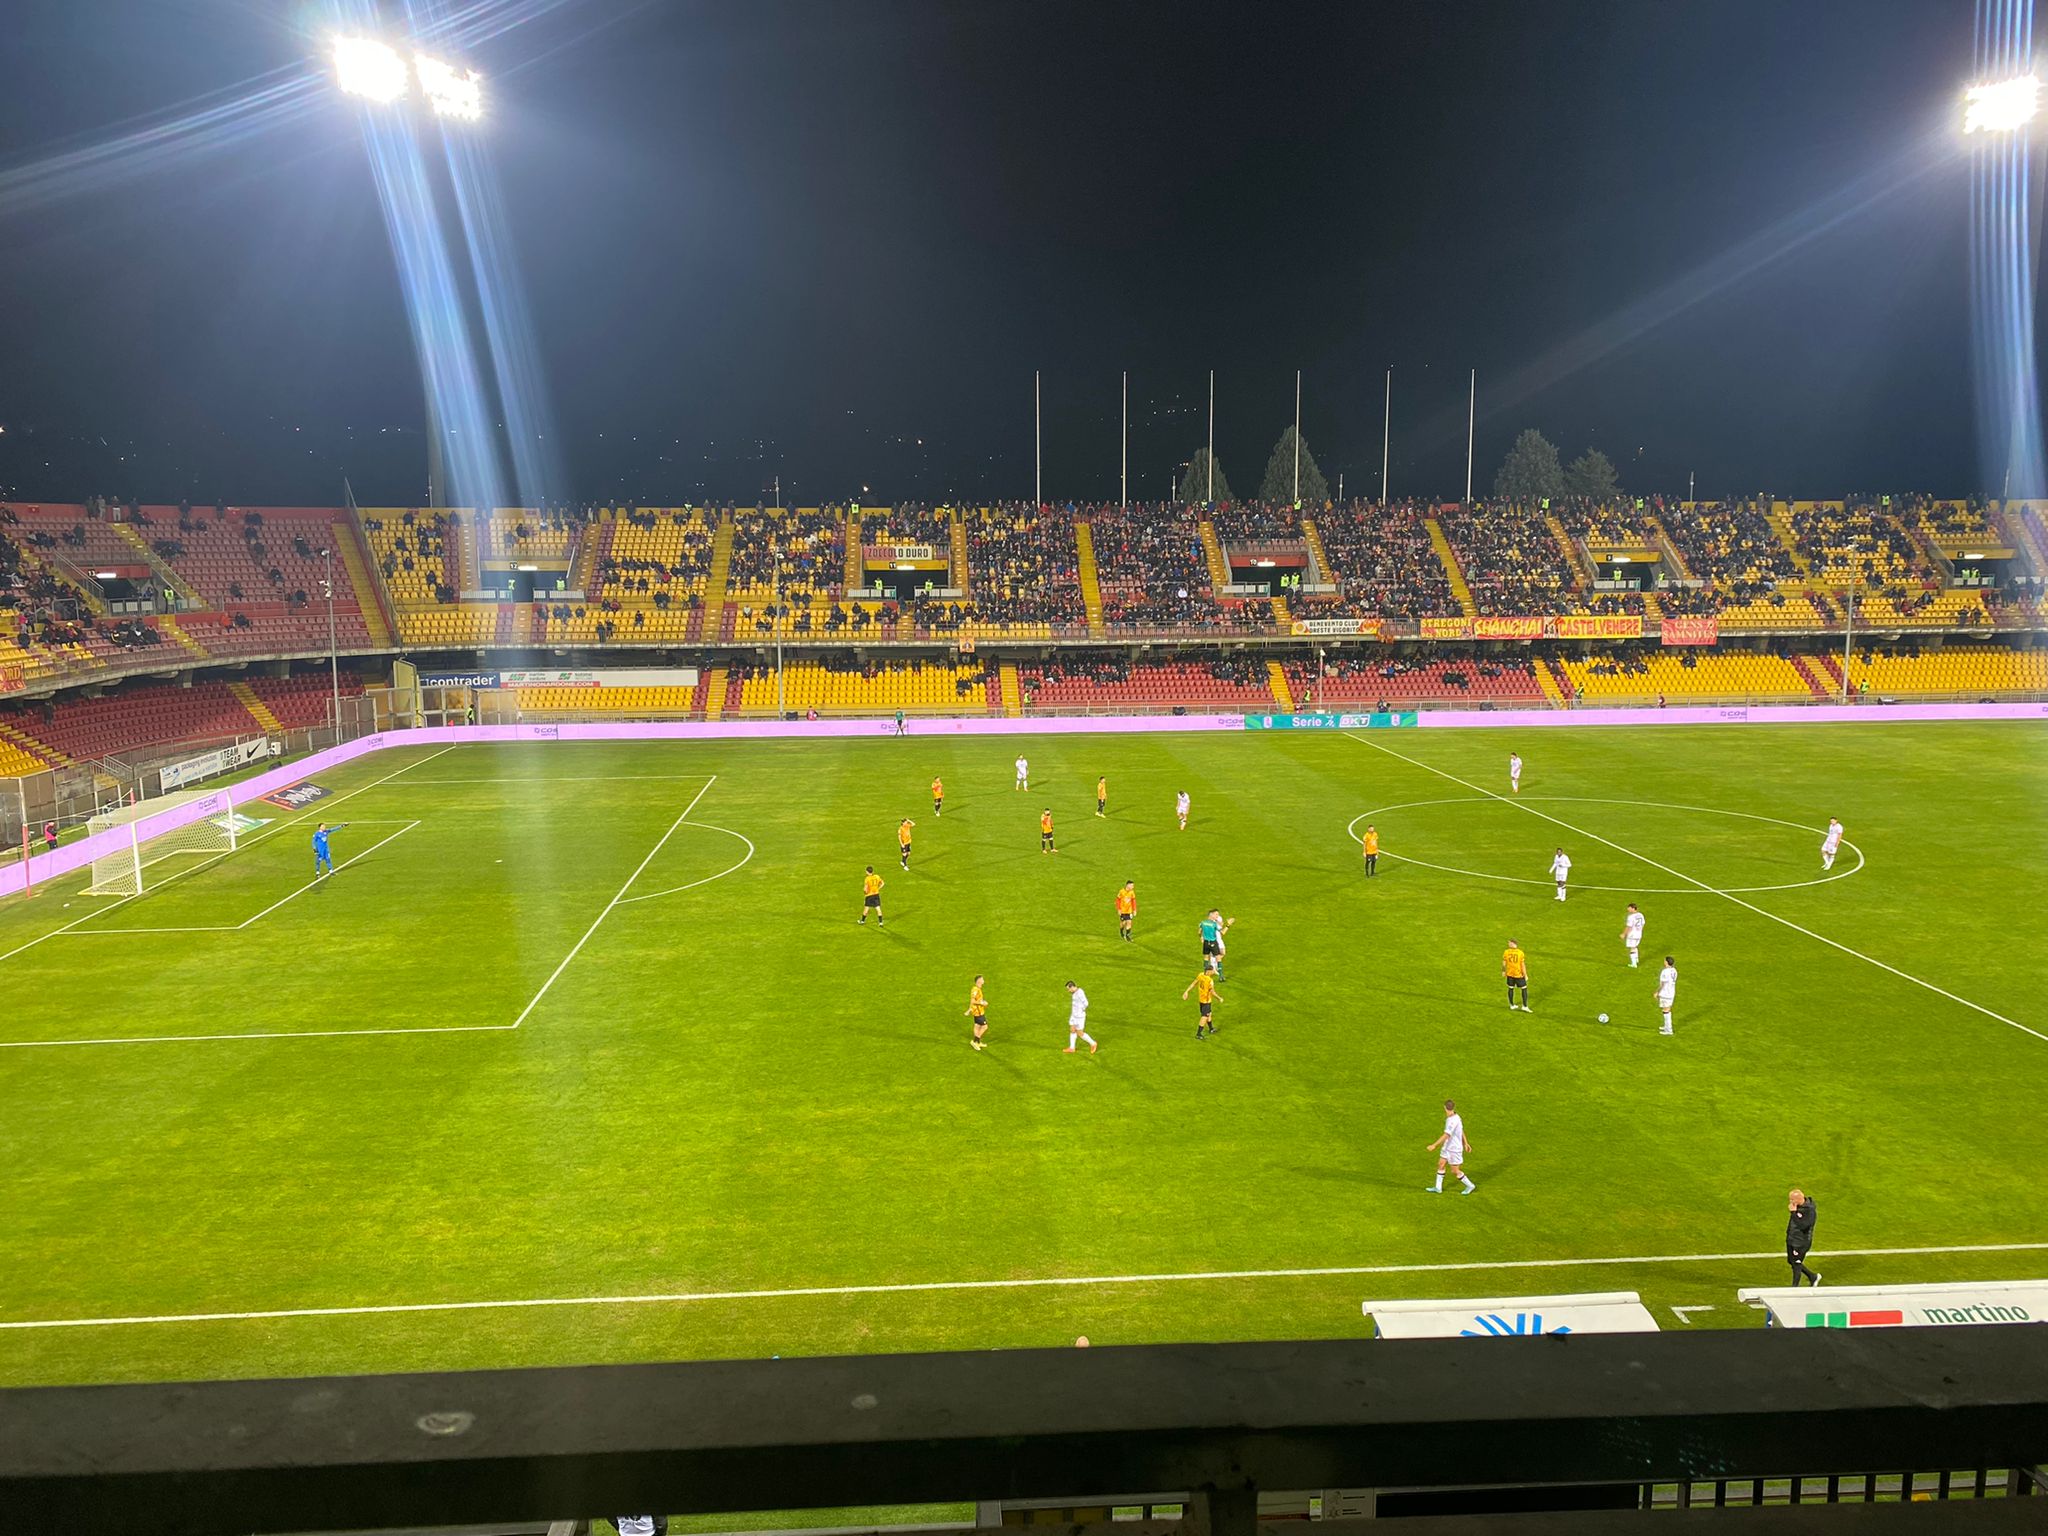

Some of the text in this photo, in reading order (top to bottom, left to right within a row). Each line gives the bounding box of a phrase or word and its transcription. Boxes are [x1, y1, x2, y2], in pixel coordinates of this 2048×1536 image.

[868, 548, 929, 558] ZOCCOLO DURO
[1421, 617, 1472, 628] STREGONI
[1474, 619, 1543, 636] SHANGHAI
[1675, 620, 1703, 629] GENS
[1436, 628, 1462, 638] NORD
[429, 675, 494, 687] contrader
[1292, 716, 1322, 727] Serie
[1922, 1302, 2030, 1324] martino
